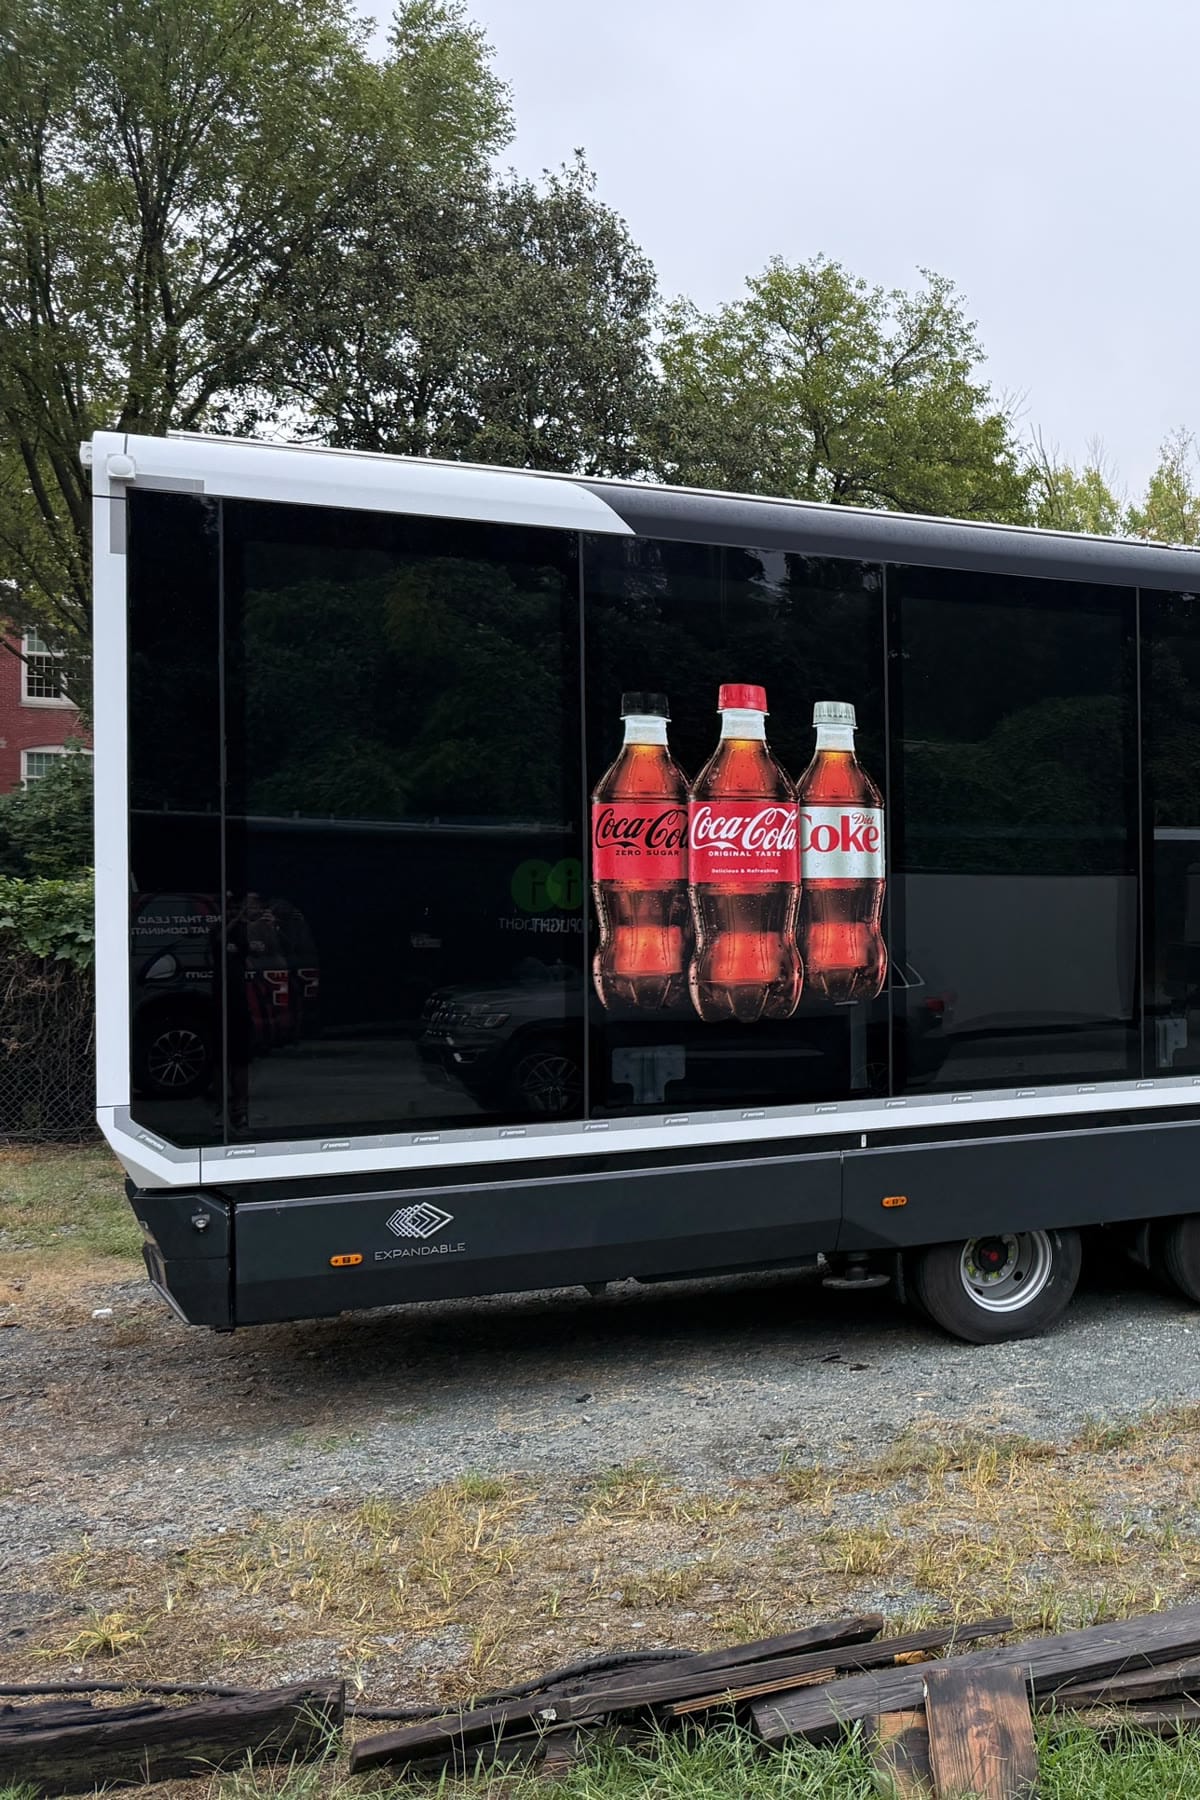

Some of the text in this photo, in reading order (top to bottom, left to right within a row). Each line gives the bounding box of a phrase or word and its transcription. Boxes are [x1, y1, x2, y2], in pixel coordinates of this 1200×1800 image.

[595, 807, 689, 850] Coca-Col
[690, 806, 799, 851] Coca-Cola
[615, 849, 681, 857] ZERO SUGAR
[707, 850, 782, 858] ORIGINAL TASTE
[746, 868, 779, 876] Refreshing
[374, 1242, 466, 1261] EXPANDABLE
